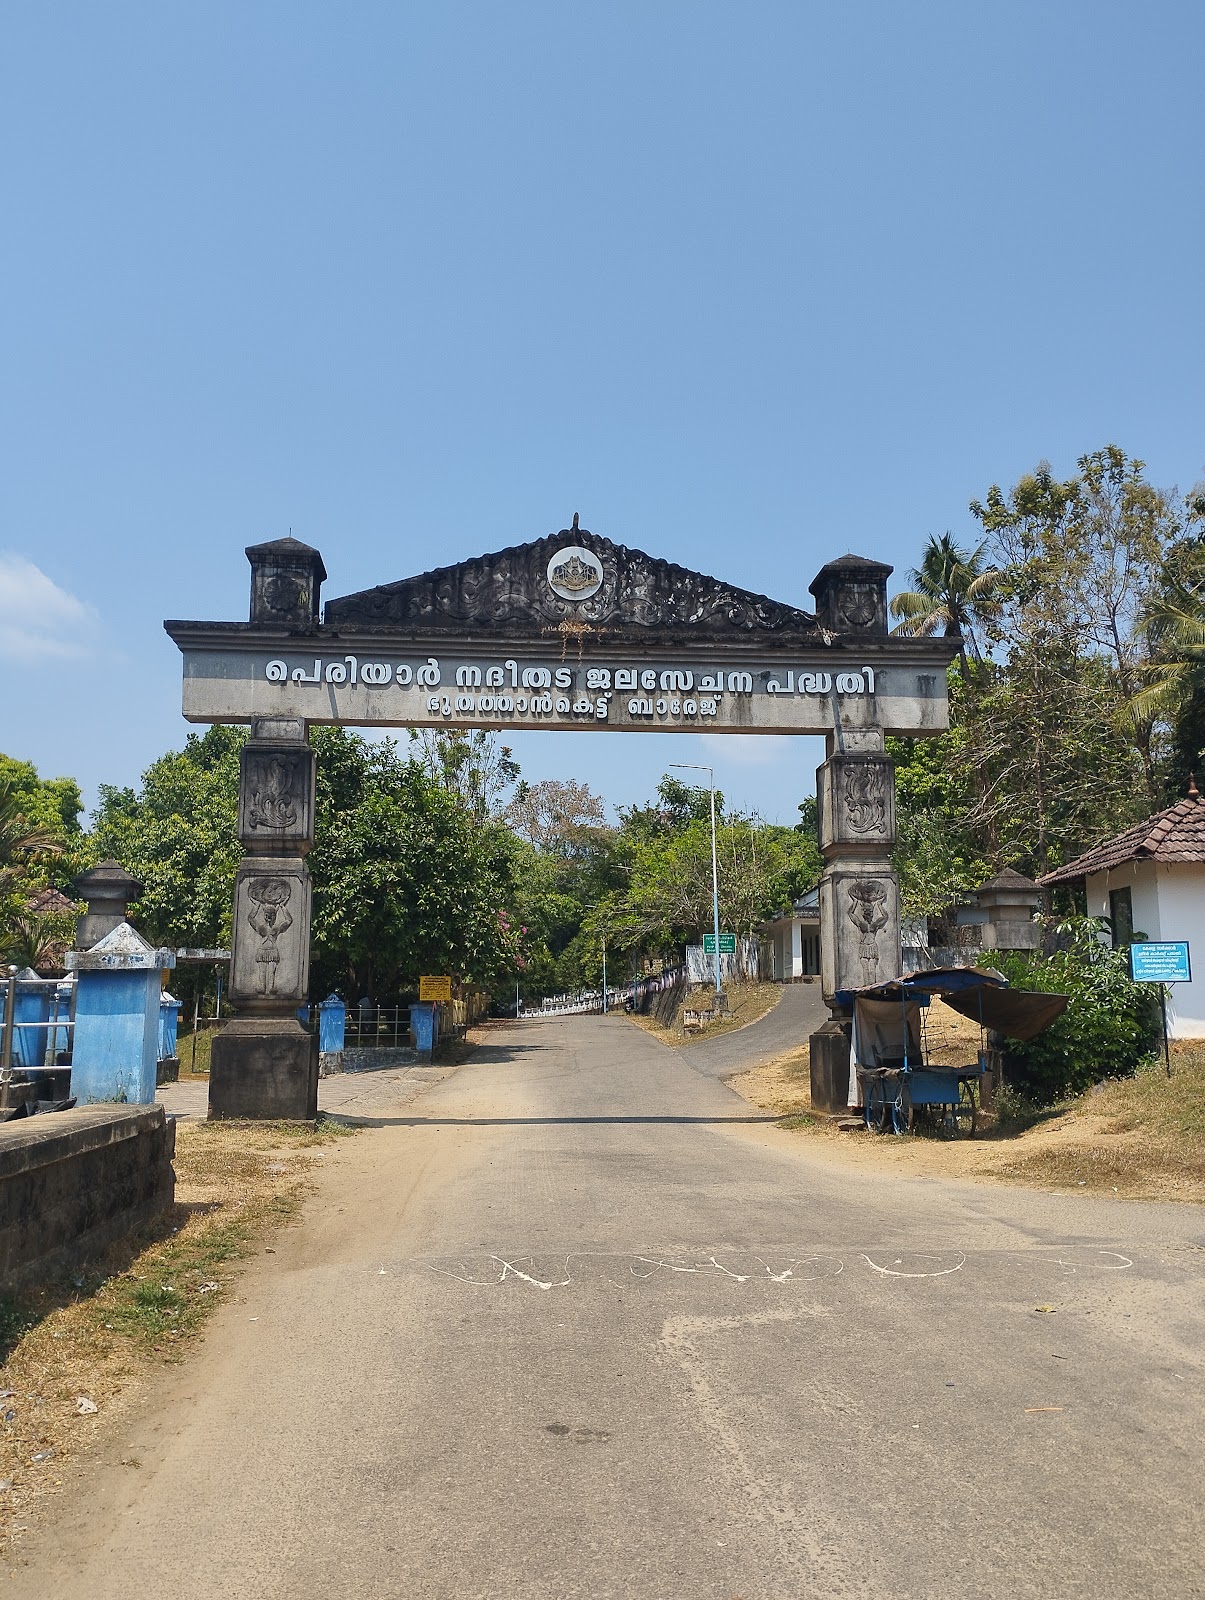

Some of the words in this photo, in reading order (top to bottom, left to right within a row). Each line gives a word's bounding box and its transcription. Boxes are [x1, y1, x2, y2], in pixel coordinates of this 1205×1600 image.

[265, 655, 441, 686] പെരിയാർ
[455, 659, 572, 688] നദീതട
[586, 667, 753, 693] ജലസേചന
[766, 666, 875, 693] പദ്ധതി
[628, 694, 721, 716] ബാരേജ്
